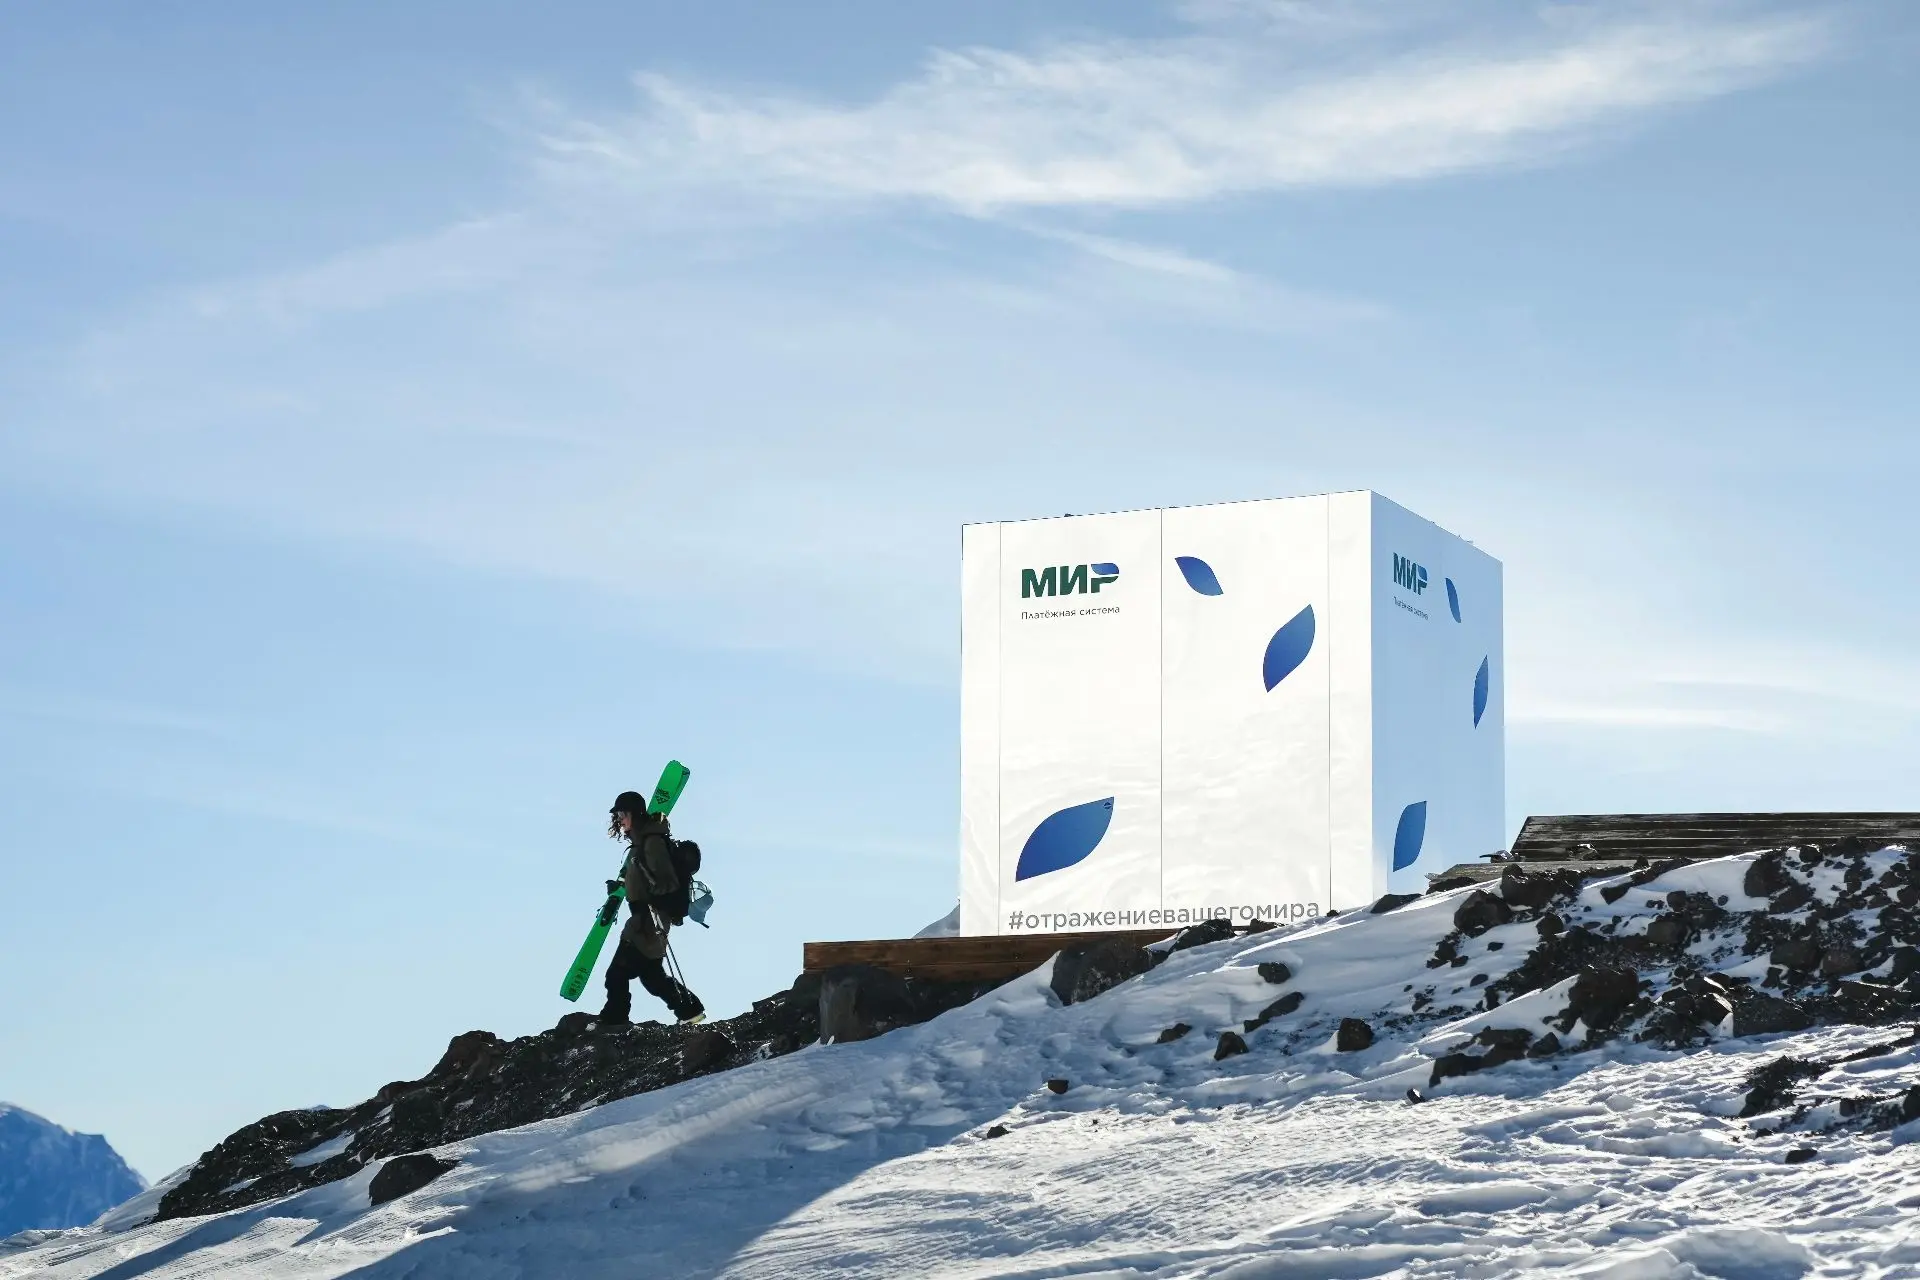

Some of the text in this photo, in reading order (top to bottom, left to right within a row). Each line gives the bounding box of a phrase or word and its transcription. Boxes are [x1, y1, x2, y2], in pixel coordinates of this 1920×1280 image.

[1022, 563, 1119, 598] МИР
[1394, 552, 1427, 595] МИР
[1021, 606, 1120, 620] Платёжная система
[1008, 902, 1319, 931] #отражениевашегомира
